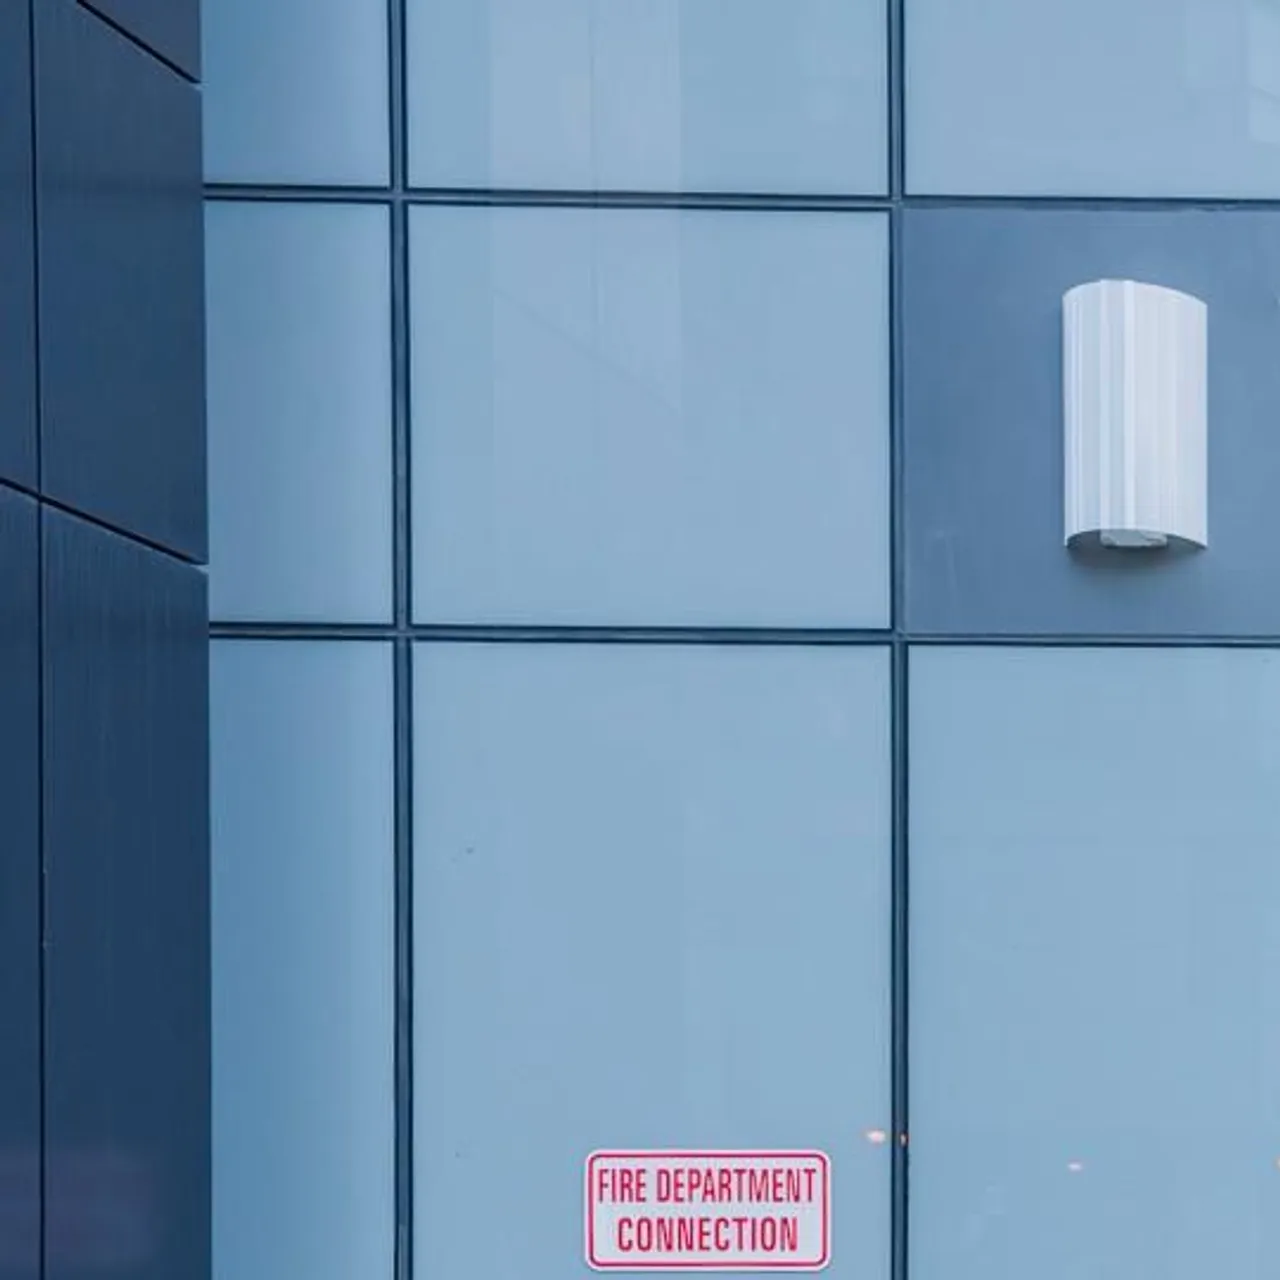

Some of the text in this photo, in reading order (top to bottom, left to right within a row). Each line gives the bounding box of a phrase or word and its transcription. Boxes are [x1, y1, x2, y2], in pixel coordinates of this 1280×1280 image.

[597, 1167, 818, 1204] FIRE DEPARTMENT
[617, 1216, 798, 1253] CONNECTION
